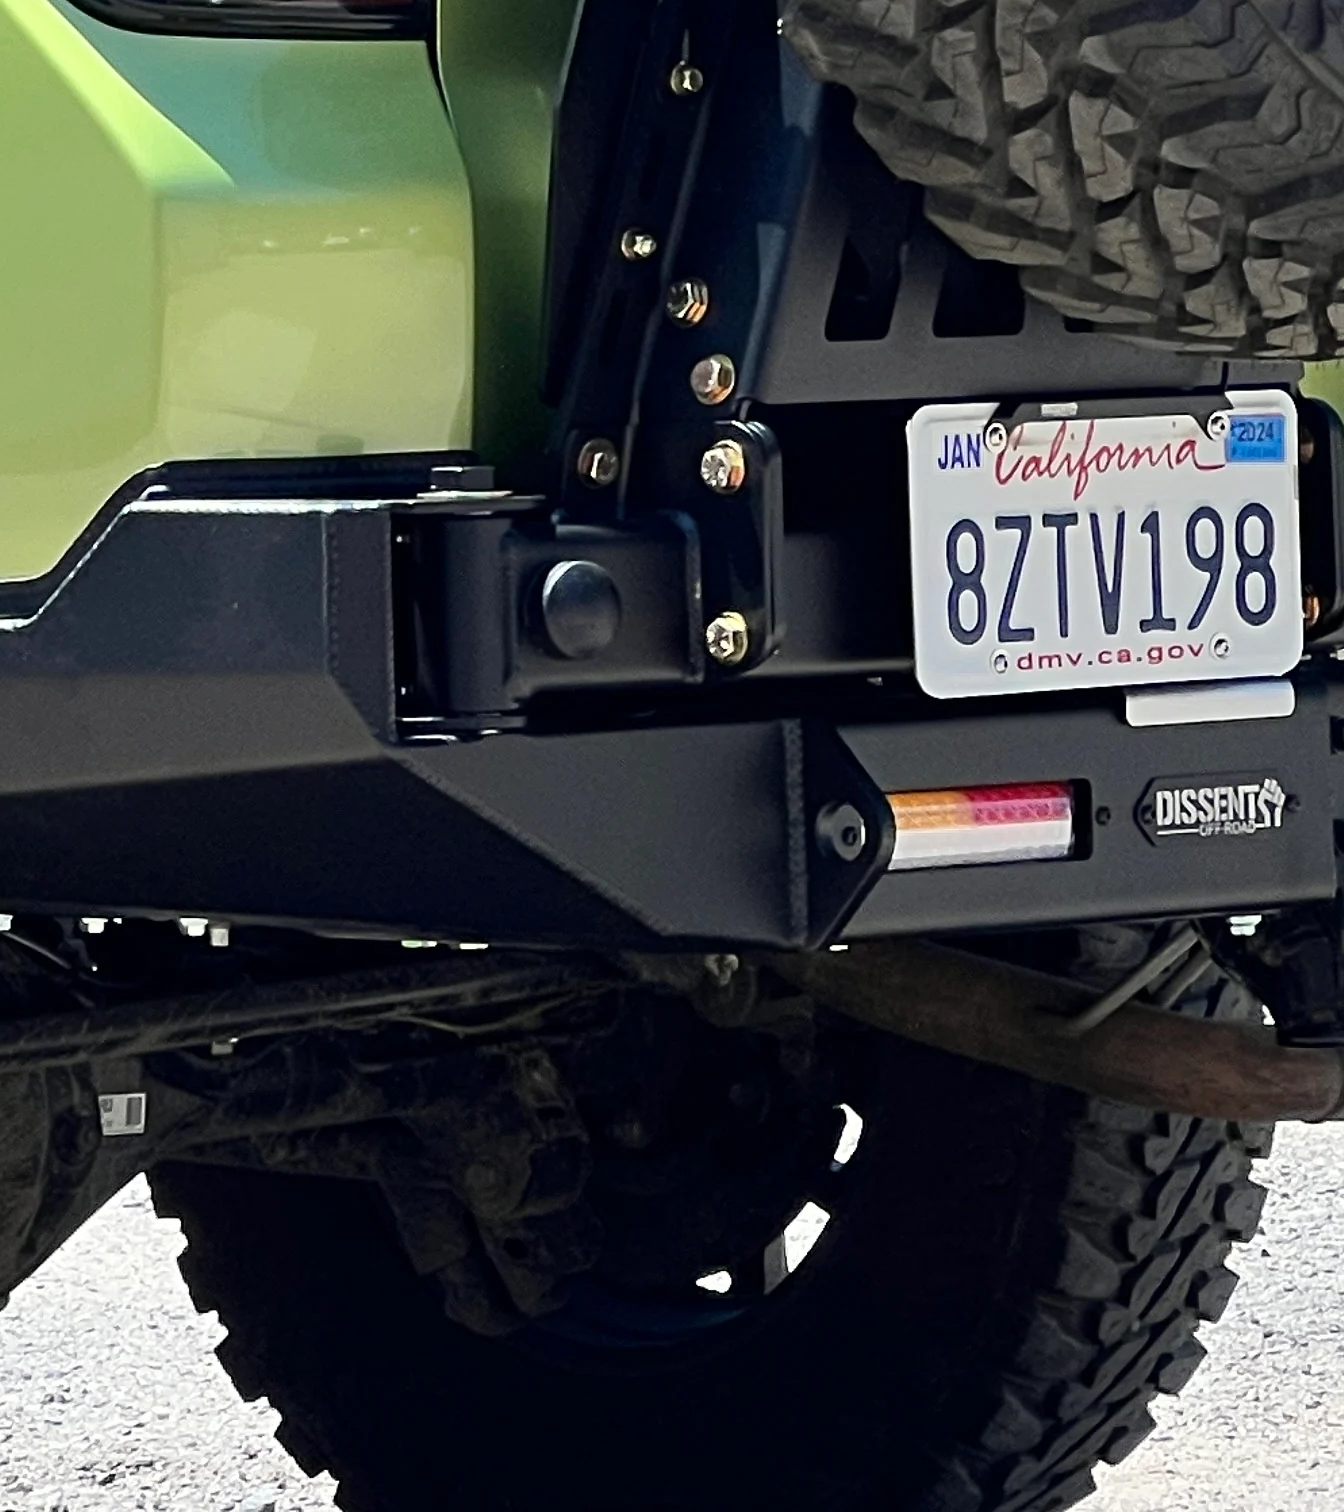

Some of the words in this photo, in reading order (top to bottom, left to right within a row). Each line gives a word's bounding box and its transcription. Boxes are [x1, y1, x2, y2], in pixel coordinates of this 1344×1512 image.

[937, 433, 982, 470] JAN
[1236, 421, 1275, 443] 2024
[994, 419, 1227, 501] California
[945, 501, 1276, 646] 8ZTV198
[1016, 641, 1205, 673] dmv.ca.gov
[1156, 784, 1260, 826] DISSENT
